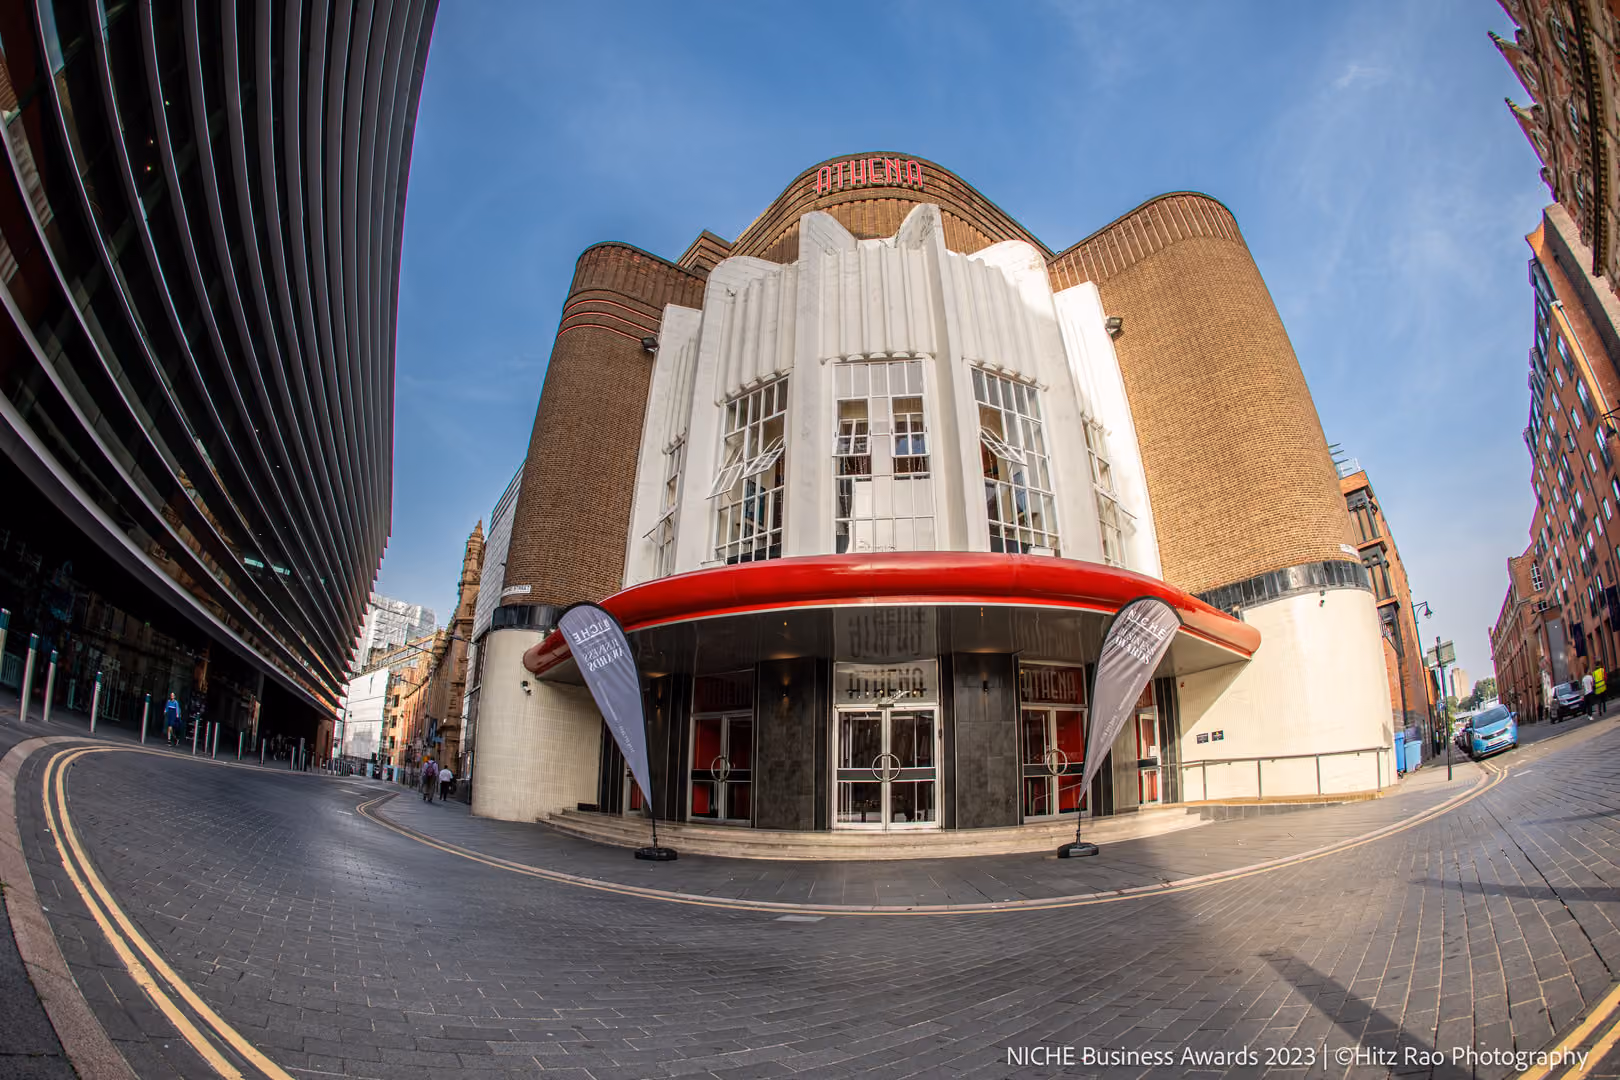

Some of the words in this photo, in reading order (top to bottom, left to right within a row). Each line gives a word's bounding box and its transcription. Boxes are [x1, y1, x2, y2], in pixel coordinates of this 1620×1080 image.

[813, 157, 923, 193] ATHENA
[1128, 609, 1167, 639] NICHE
[1022, 670, 1077, 699] ATHENA
